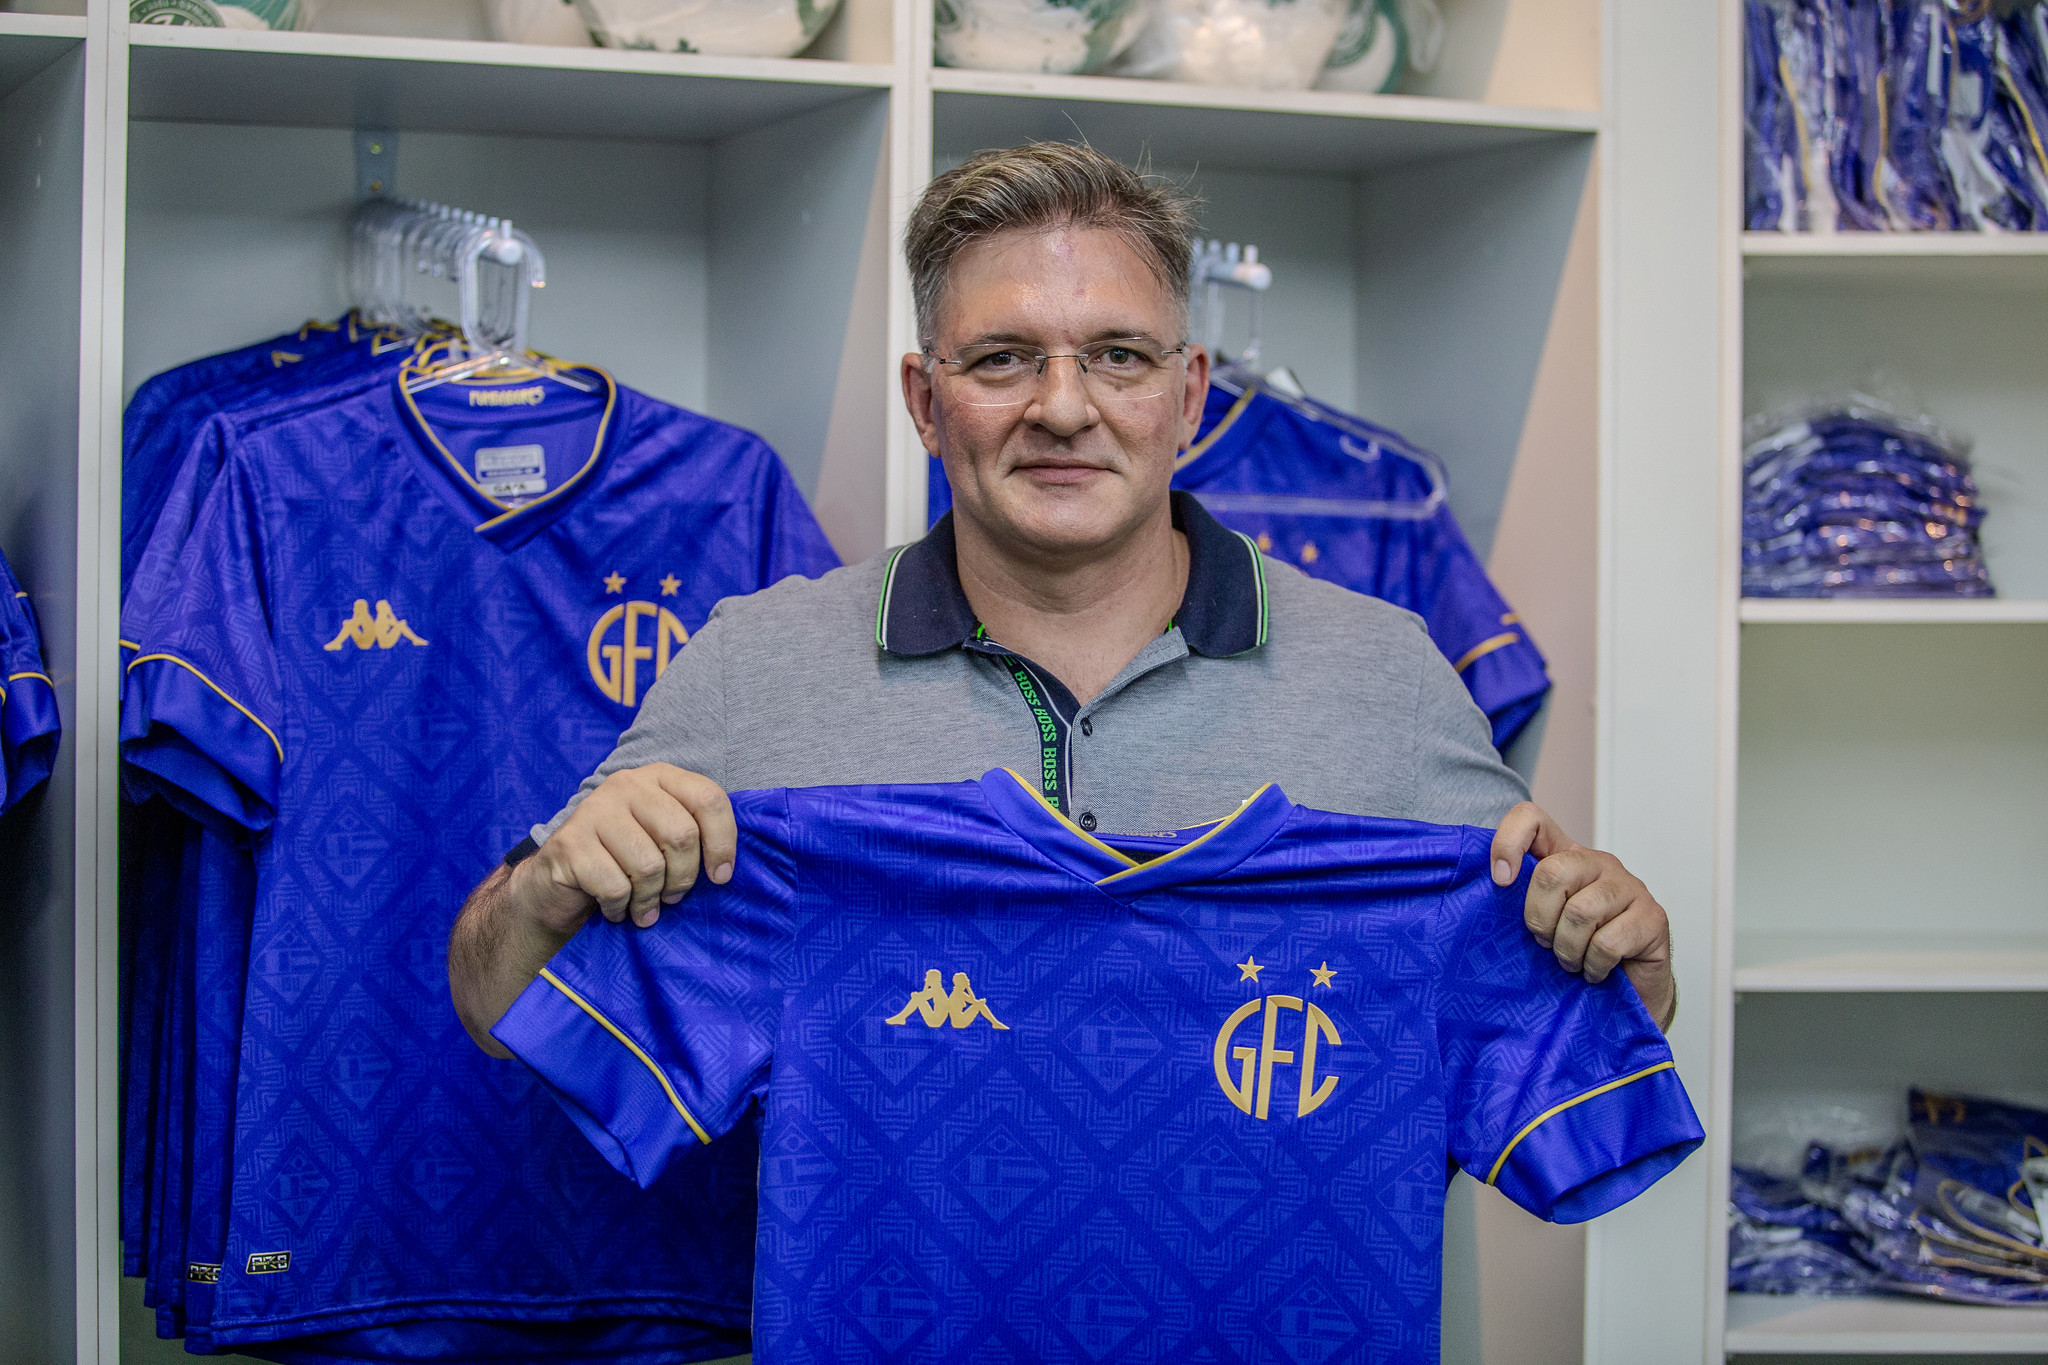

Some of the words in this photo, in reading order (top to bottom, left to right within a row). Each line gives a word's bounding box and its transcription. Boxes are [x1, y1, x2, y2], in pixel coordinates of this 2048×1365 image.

[1014, 670, 1042, 707] BOSS
[1033, 708, 1057, 743] BOSS
[1043, 747, 1058, 791] BOSS
[1213, 994, 1342, 1121] GFC
[252, 1255, 288, 1271] PRO
